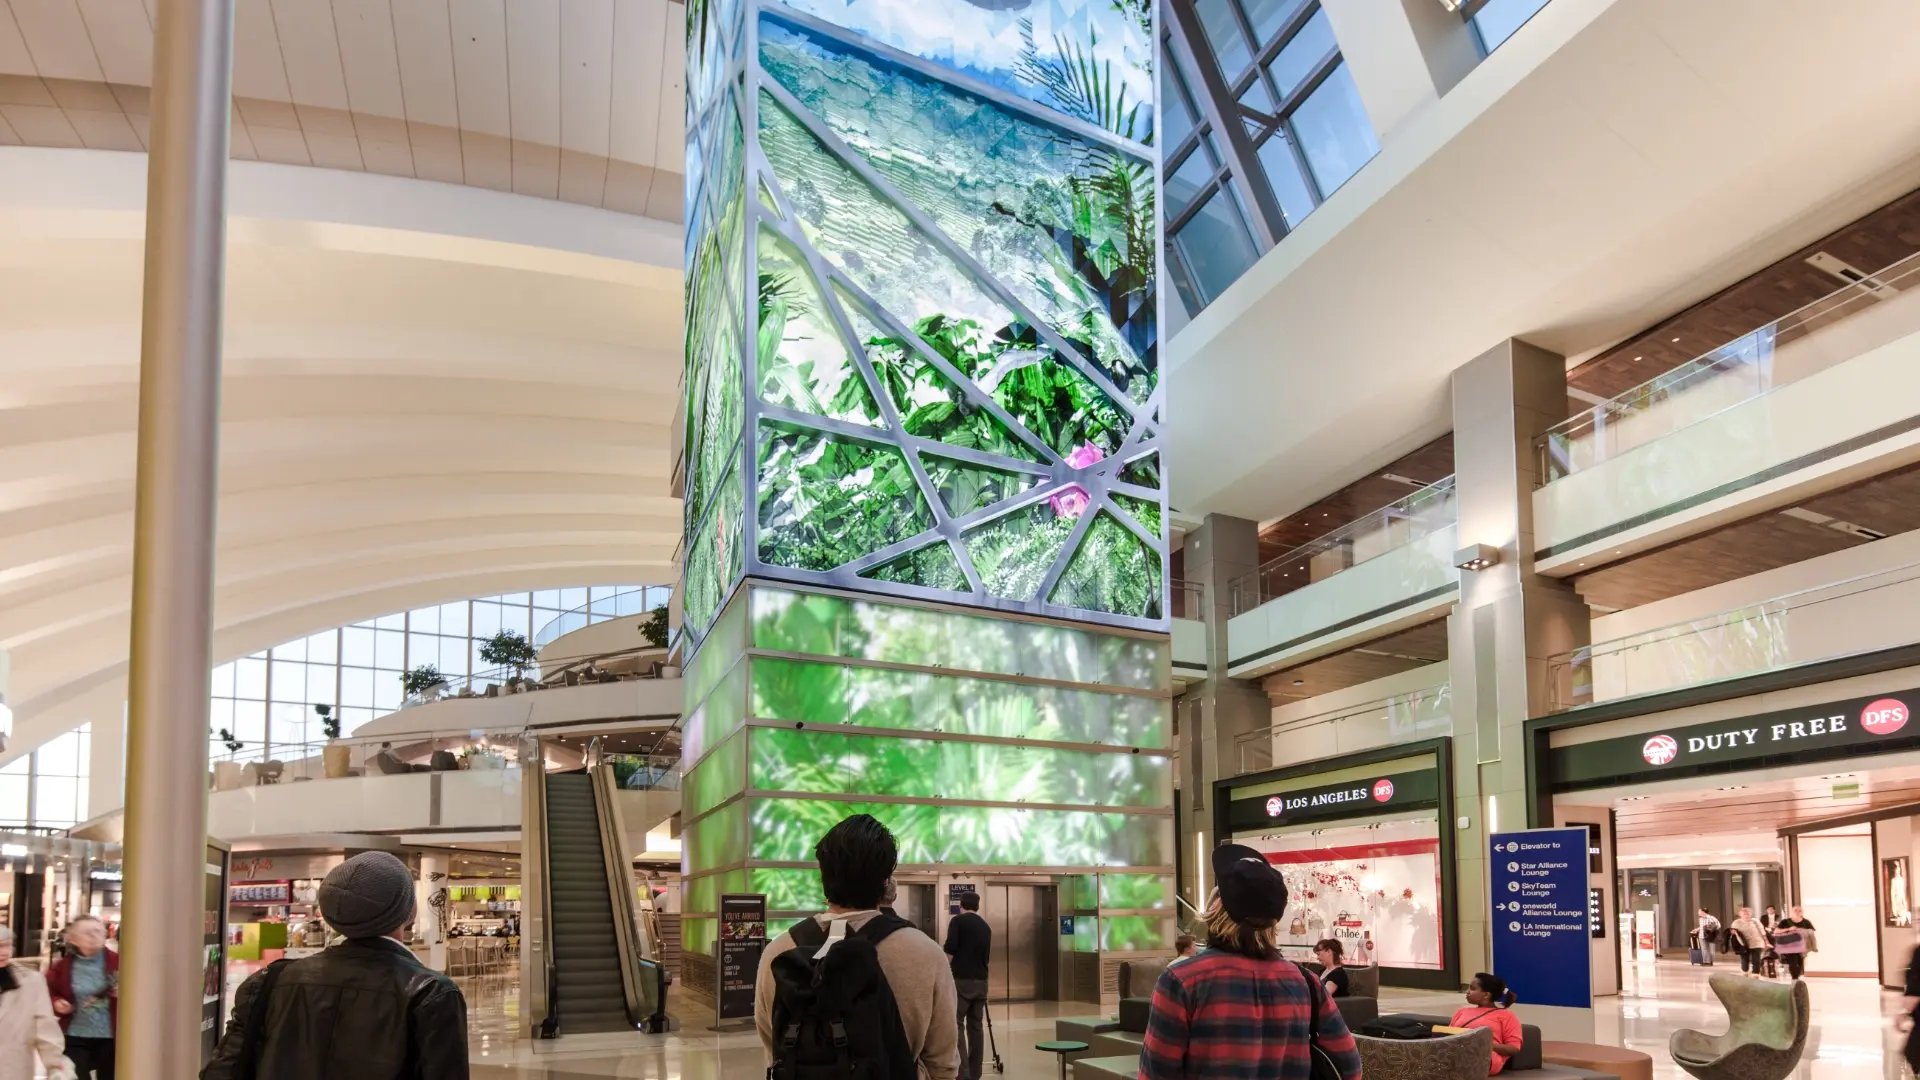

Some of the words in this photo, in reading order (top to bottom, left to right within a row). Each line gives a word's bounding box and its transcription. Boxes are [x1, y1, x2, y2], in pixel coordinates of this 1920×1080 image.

[1865, 708, 1903, 726] DFS
[1688, 729, 1759, 753] DUTY
[1771, 715, 1847, 741] FREE
[1375, 786, 1391, 796] DFS
[1286, 797, 1308, 809] LOS
[1311, 788, 1368, 806] ANGELES
[1521, 869, 1549, 877] Lounge
[1522, 882, 1557, 890] SkyTeam
[1553, 910, 1583, 918] Lounge
[1535, 923, 1582, 931] International
